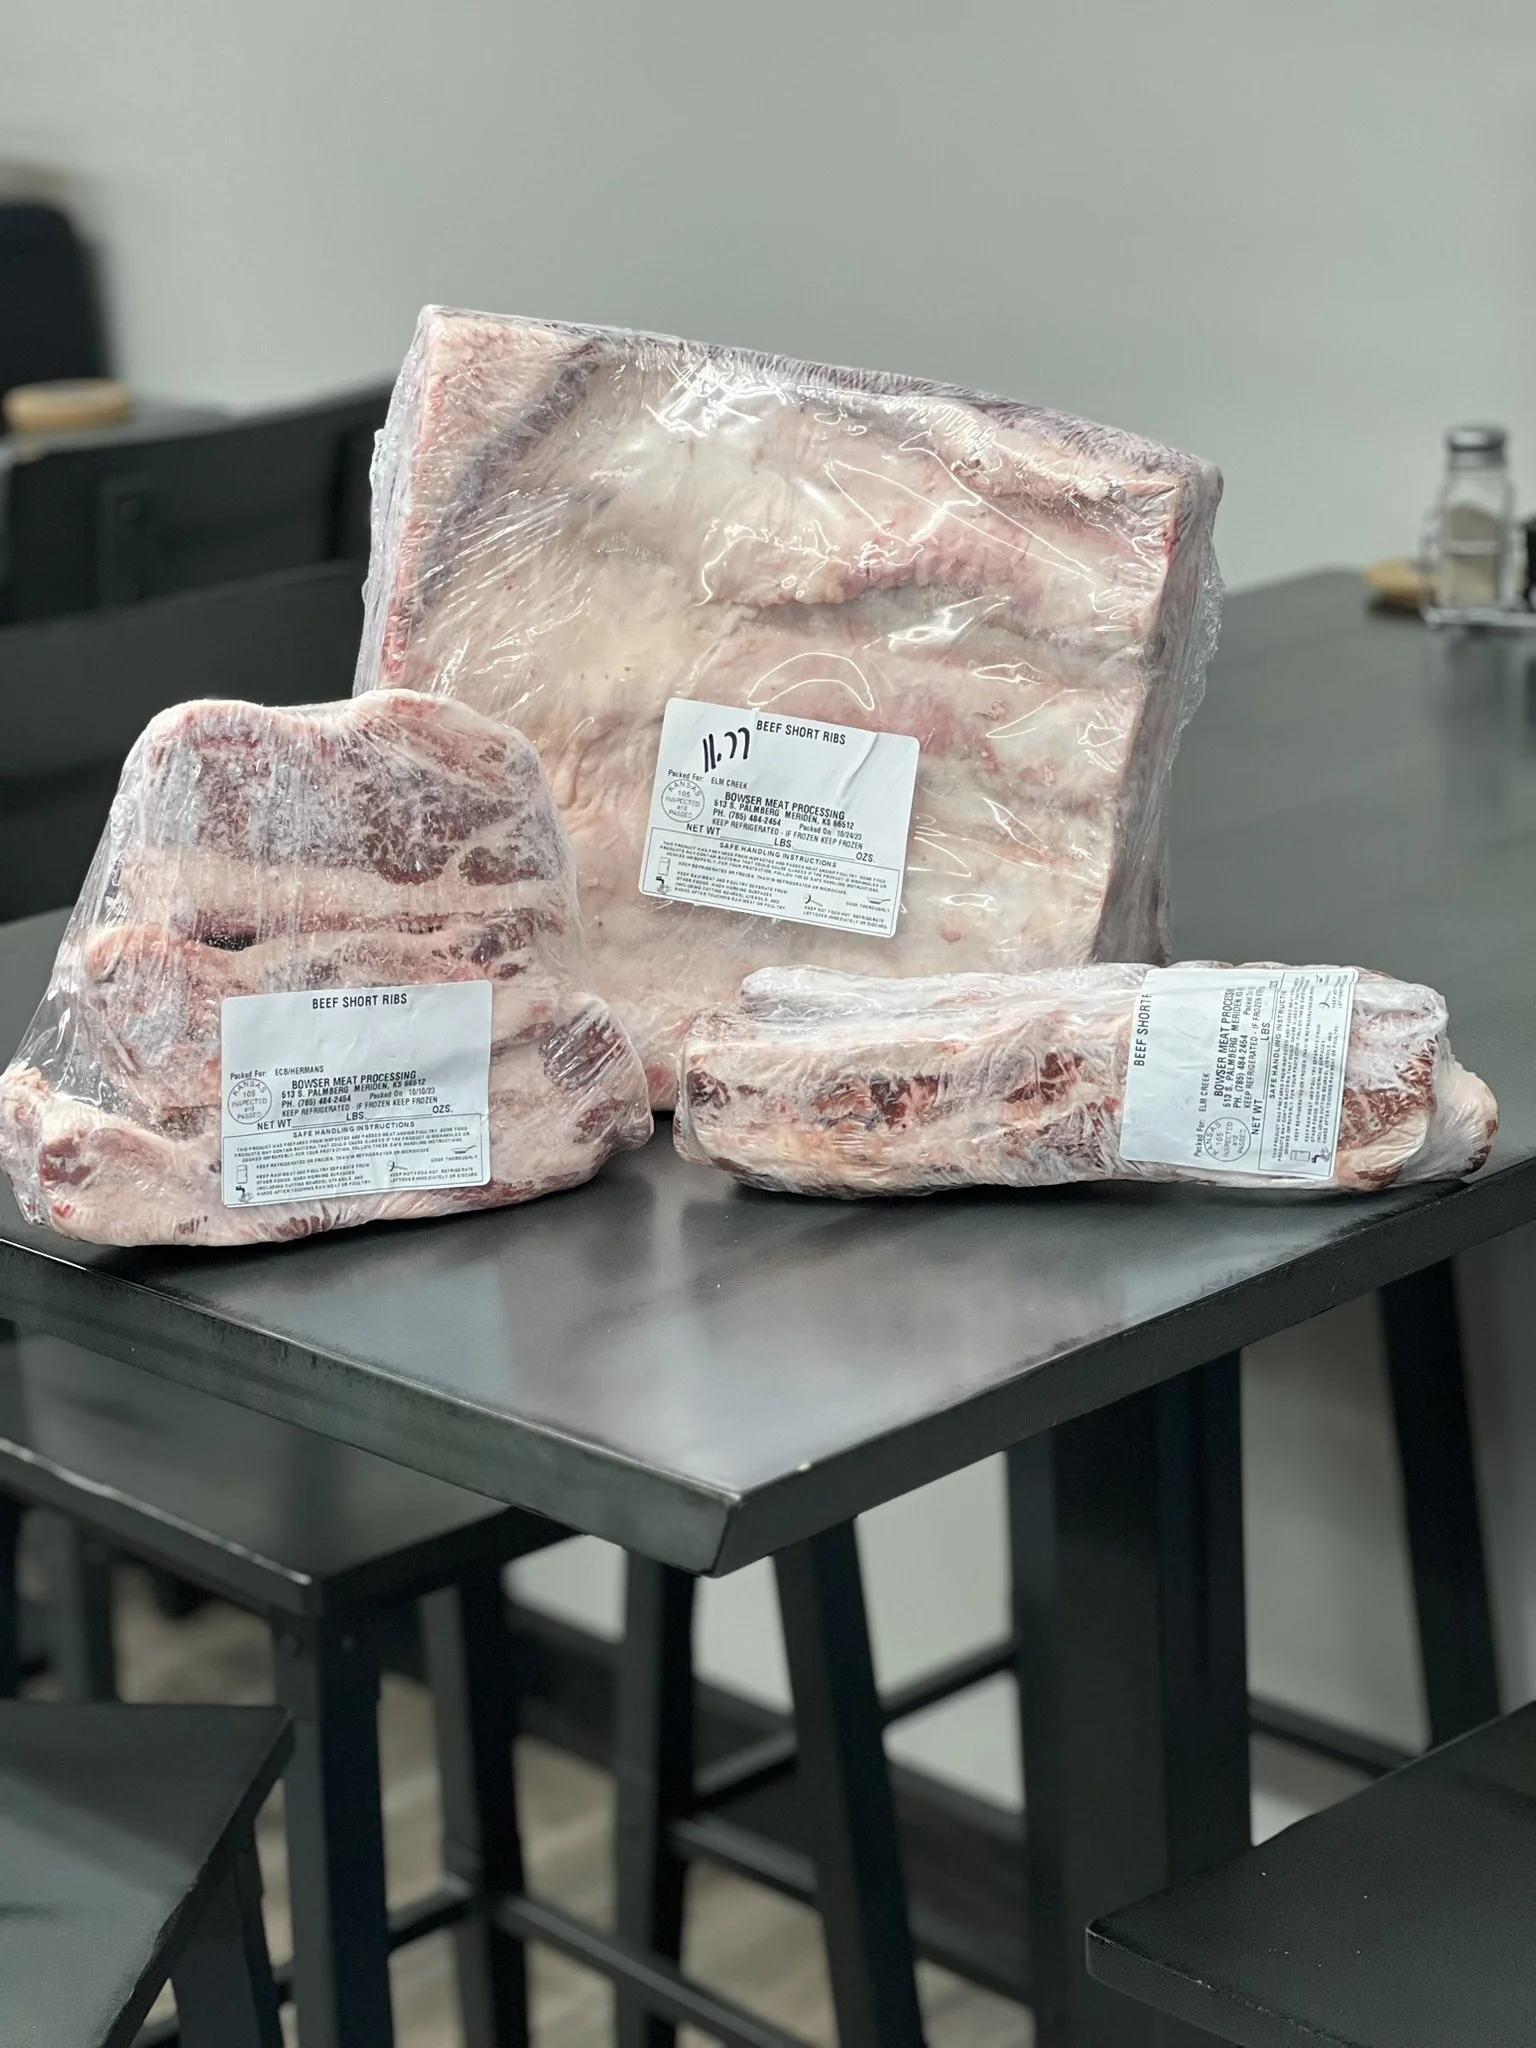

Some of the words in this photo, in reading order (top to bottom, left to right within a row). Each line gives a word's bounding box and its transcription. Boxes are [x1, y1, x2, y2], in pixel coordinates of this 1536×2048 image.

[756, 720, 782, 733] BEEF
[785, 724, 820, 740] SHORT
[823, 731, 846, 745] RIBS
[703, 727, 750, 773] 11.77
[668, 769, 690, 779] Packed
[711, 776, 725, 786] ELM
[726, 779, 748, 789] CREEK
[668, 779, 703, 797] KANSAS
[714, 799, 727, 808] 513
[729, 802, 737, 810] S.
[739, 803, 780, 817] PALMBERG
[822, 817, 831, 826] KS
[833, 819, 854, 830] 66512
[725, 791, 762, 806] BOWSER
[765, 798, 790, 811] MEAT
[792, 802, 845, 820] PROCESSING
[686, 823, 704, 833] NET
[706, 826, 721, 836] WT
[713, 808, 726, 817] PH.
[749, 814, 781, 826] 484-2454
[799, 823, 821, 833] Packed
[712, 818, 729, 827] KEEP
[730, 820, 779, 836] REFRIGERATED
[793, 831, 819, 842] FROZEN
[821, 836, 837, 845] KEEP
[838, 839, 863, 850] FROZEN
[720, 842, 739, 851] SAFE
[741, 845, 780, 858] HANDLING
[782, 853, 837, 868] INSTRUCTIONS
[313, 997, 338, 1009] BEEF
[343, 995, 378, 1008] SHORT
[383, 993, 407, 1005] RIBS
[1254, 998, 1263, 1021] FROZEN
[1137, 999, 1151, 1035] SHORT
[1218, 1027, 1230, 1053] MEAT
[1133, 1038, 1147, 1067] BEEF
[1226, 1038, 1238, 1081] PALMBERG
[1237, 1035, 1249, 1070] 484-2454
[1246, 1037, 1258, 1089] REFRIGERATED
[1272, 1034, 1282, 1075] HANDLING
[230, 1071, 252, 1080] Packed
[275, 1065, 324, 1076] ECB/HERMANS
[292, 1077, 330, 1089] BOWSER
[333, 1075, 357, 1086] MEAT
[361, 1070, 416, 1084] PROCESSING
[1214, 1057, 1227, 1096] BOWSER
[232, 1080, 266, 1097] KANSAS
[243, 1090, 256, 1098] 105
[282, 1090, 295, 1099] 513
[308, 1086, 348, 1096] PALMBERG
[354, 1082, 389, 1092] MERIDEN,
[393, 1080, 402, 1088] KS
[405, 1078, 426, 1087] 66512
[1201, 1073, 1210, 1096] CREEK
[1225, 1084, 1233, 1092] S.
[282, 1100, 295, 1108] PH.
[319, 1095, 351, 1105] 484-2454
[370, 1090, 392, 1100] Packed
[282, 1109, 299, 1117] KEEP
[301, 1104, 349, 1115] REFRIGERATED
[365, 1100, 390, 1109] FROZEN
[393, 1098, 410, 1106] KEEP
[412, 1096, 438, 1105] FROZEN
[1199, 1098, 1208, 1112] ELM
[1223, 1094, 1232, 1107] 513
[1234, 1095, 1242, 1108] PH.
[1244, 1091, 1253, 1108] KEEP
[1253, 1099, 1263, 1114] WT
[257, 1120, 274, 1130] NET
[277, 1119, 292, 1128] WT
[346, 1111, 367, 1121] LBS.
[432, 1104, 453, 1114] OZS.
[1251, 1117, 1261, 1134] NET
[293, 1130, 312, 1138] SAFE
[315, 1126, 354, 1136] HANDLING
[357, 1121, 415, 1132] INSTRUCTIONS
[1205, 1121, 1222, 1156] KANSAS
[1216, 1132, 1224, 1145] 105
[1194, 1134, 1204, 1157] Packed
